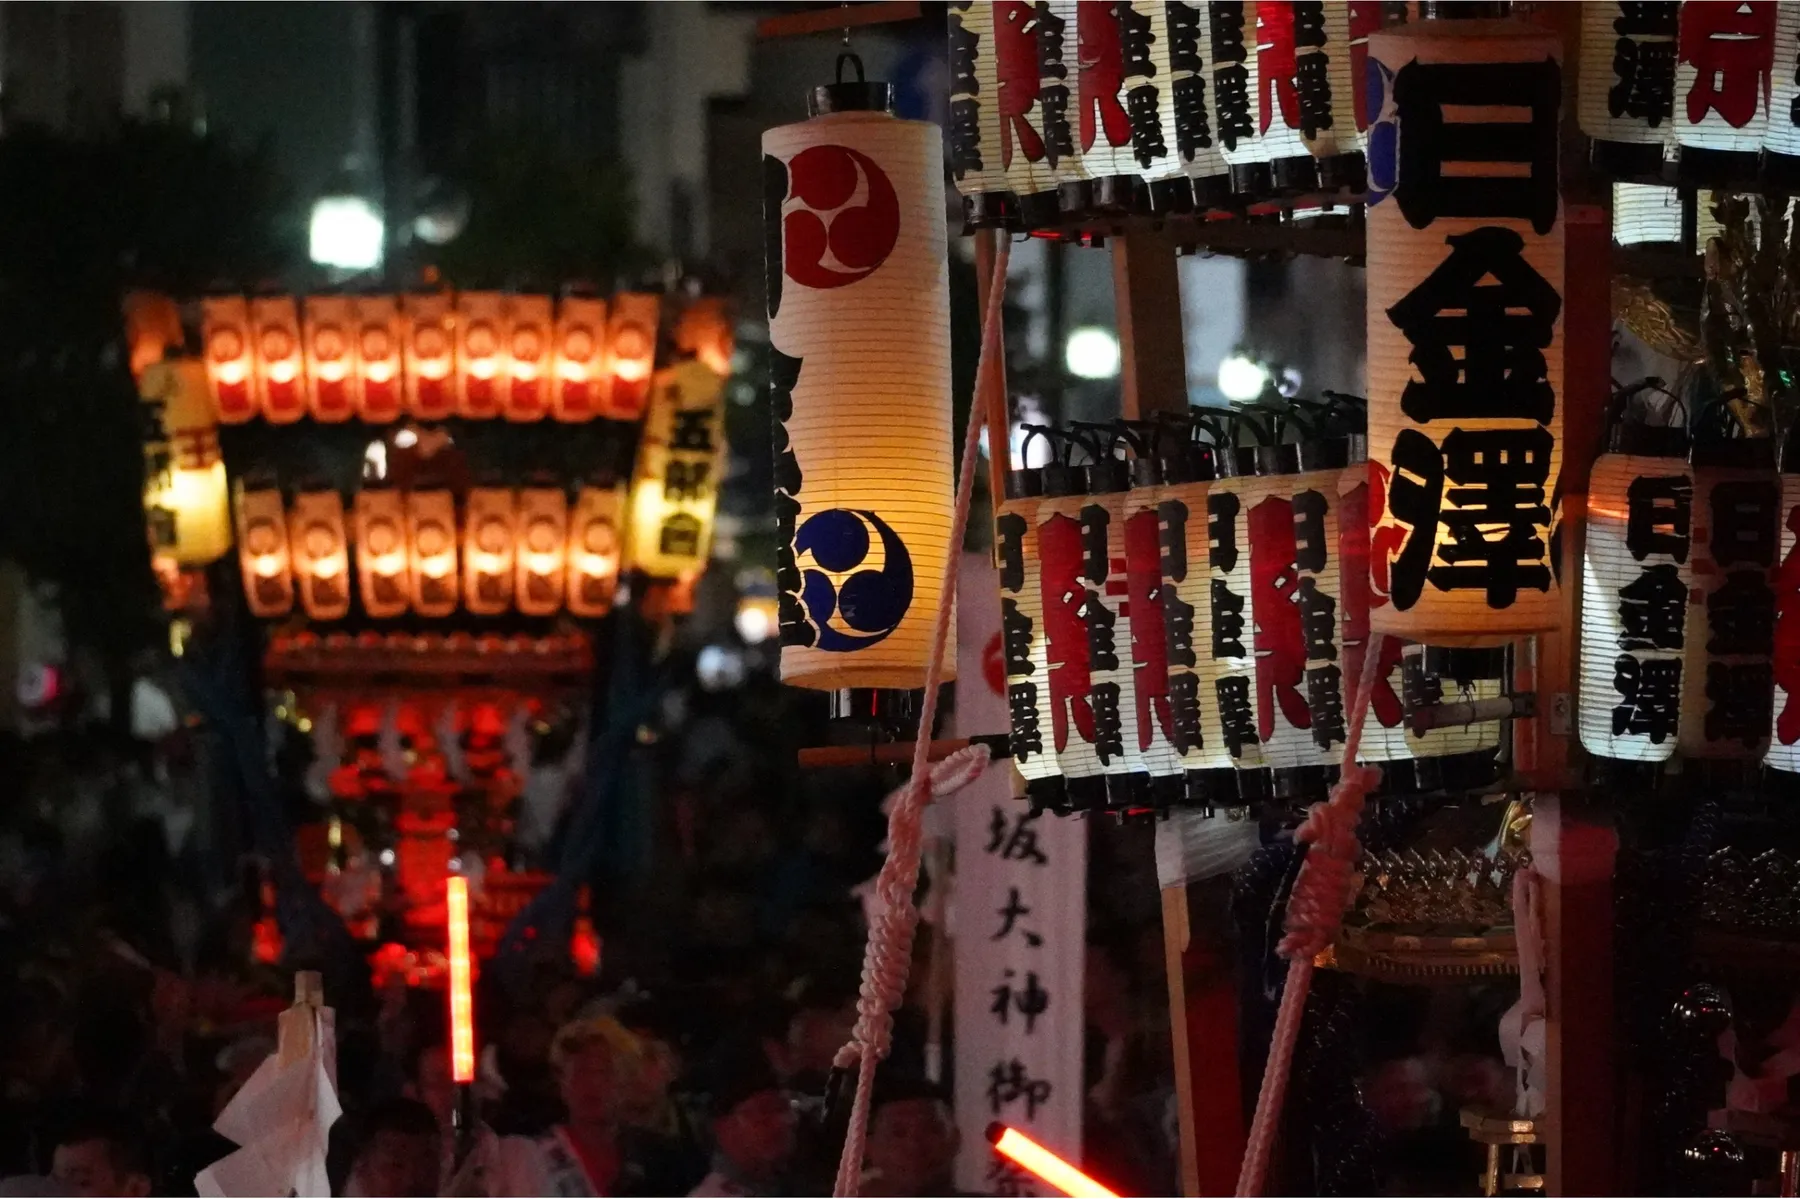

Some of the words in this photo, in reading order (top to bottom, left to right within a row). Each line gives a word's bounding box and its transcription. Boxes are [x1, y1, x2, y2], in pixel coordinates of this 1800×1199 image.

[1386, 53, 1562, 611] 日金澤
[1612, 475, 1693, 744] 日金澤
